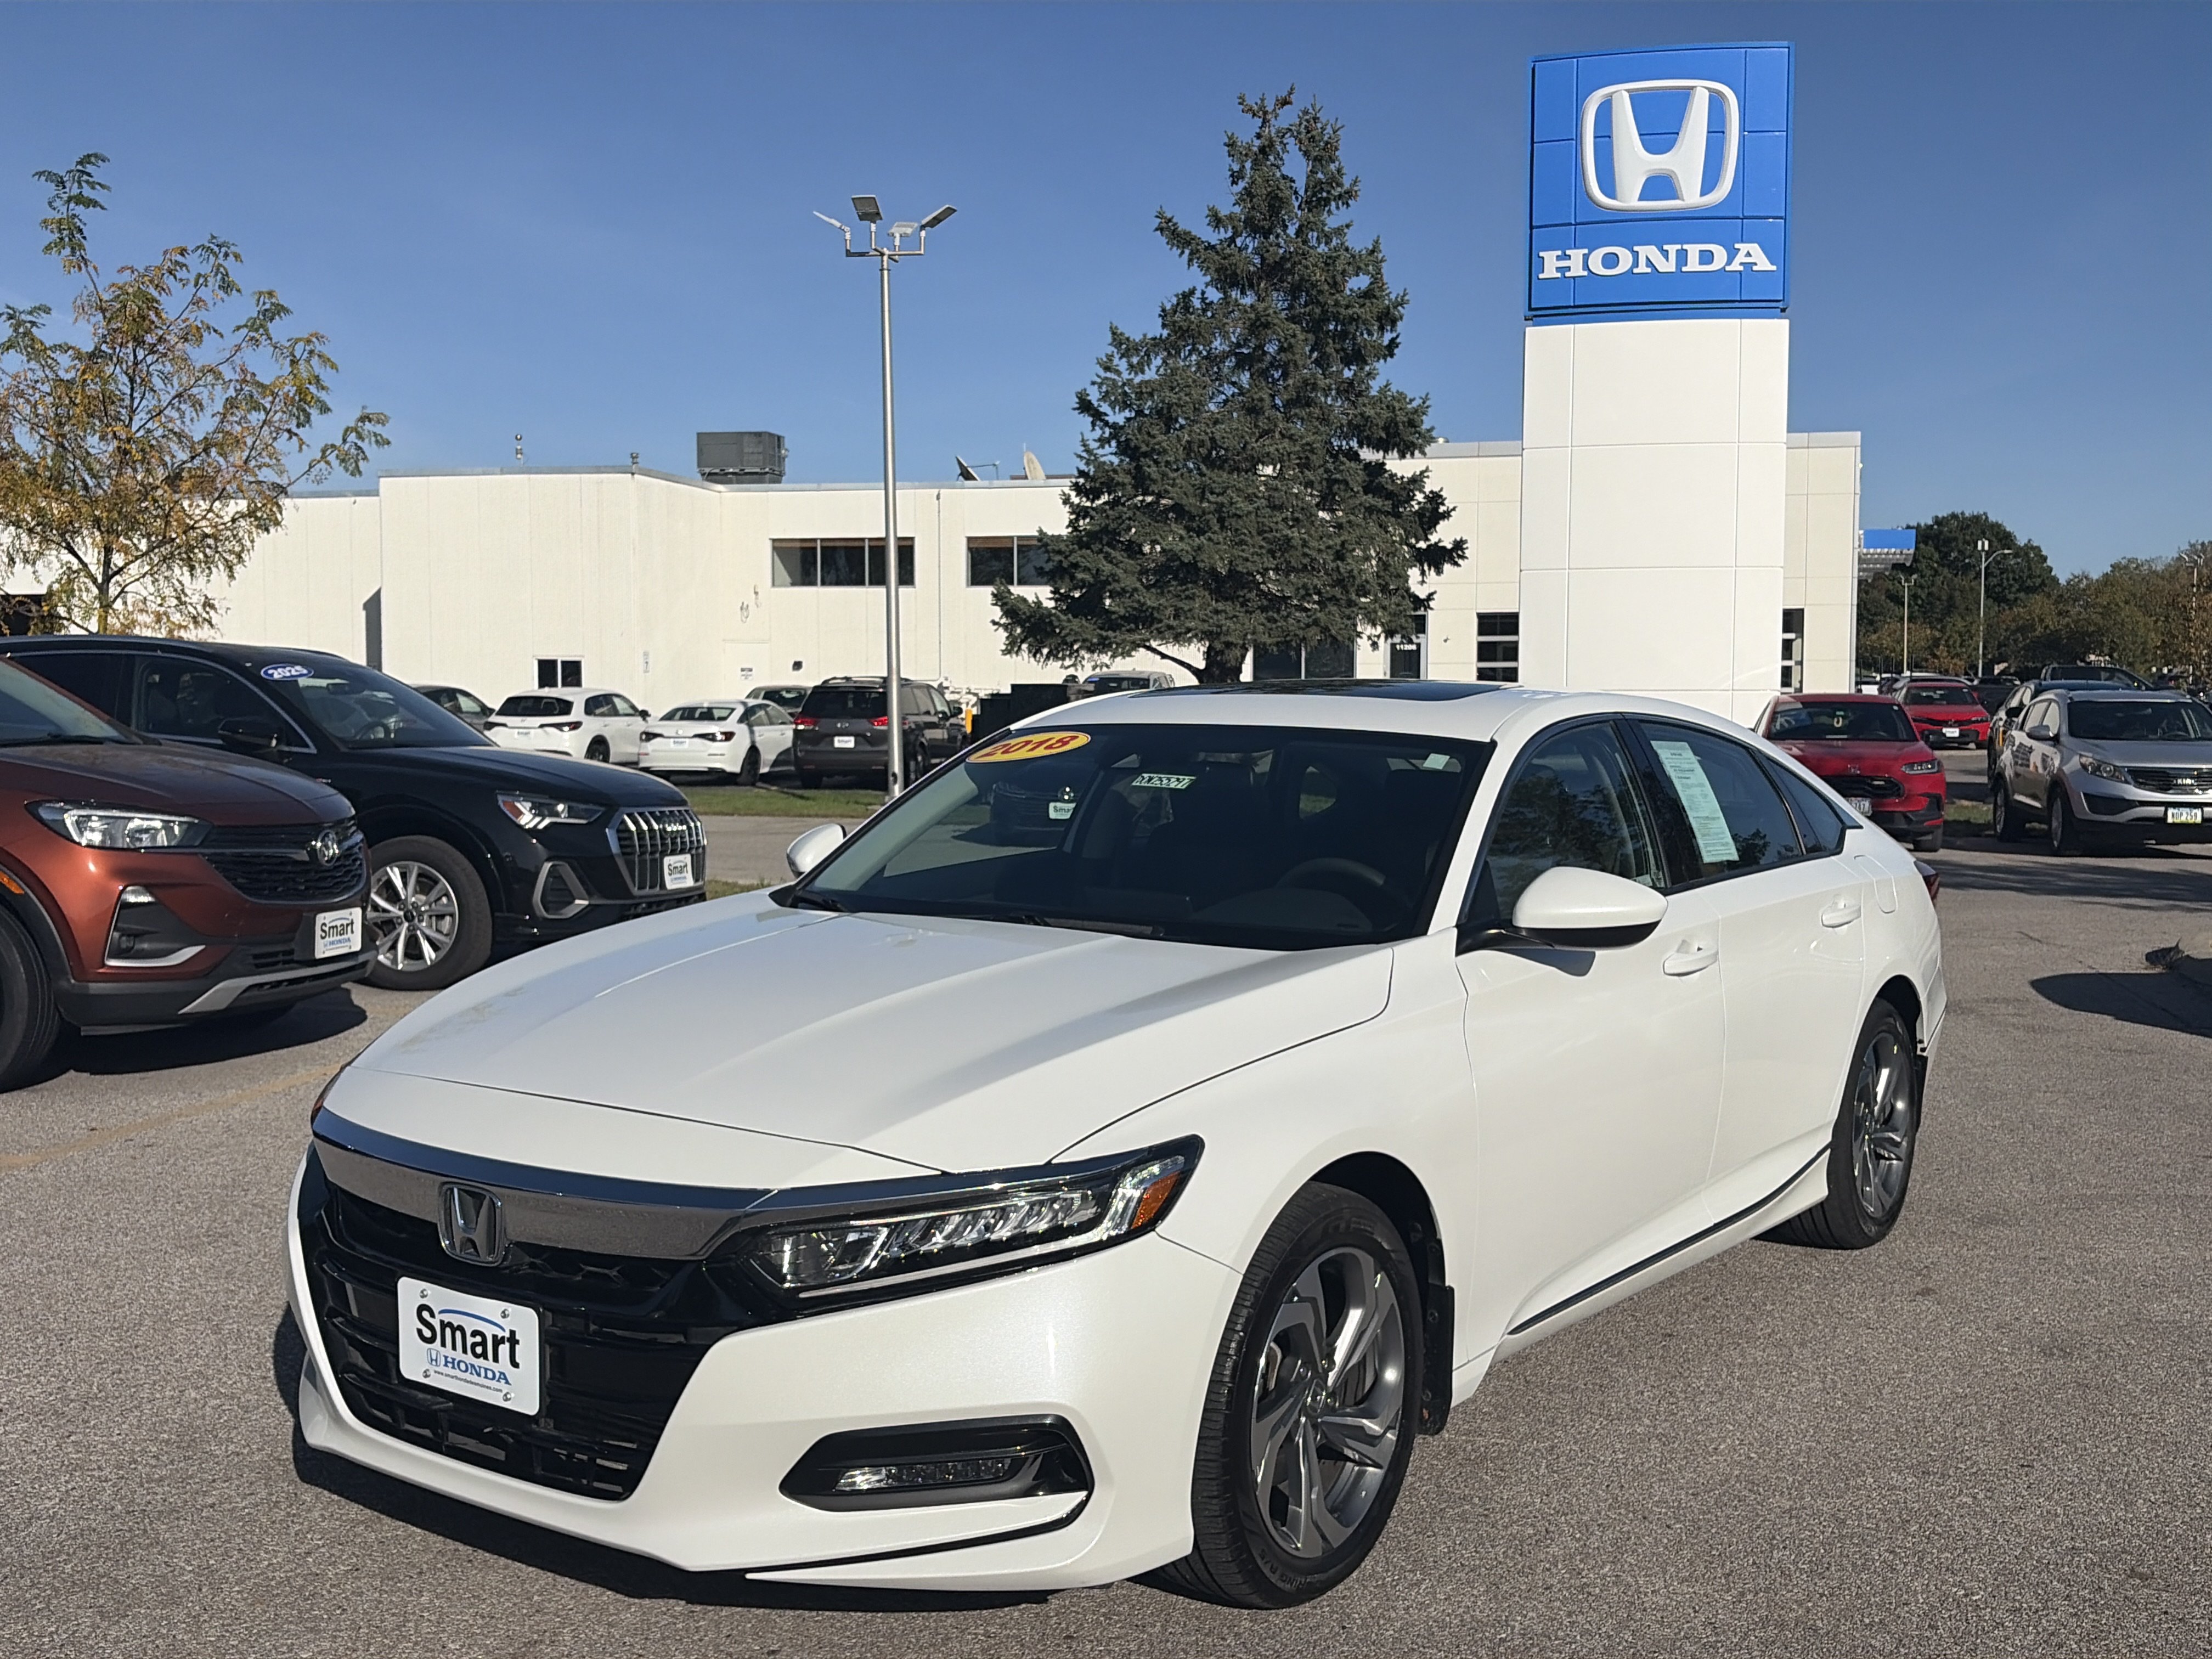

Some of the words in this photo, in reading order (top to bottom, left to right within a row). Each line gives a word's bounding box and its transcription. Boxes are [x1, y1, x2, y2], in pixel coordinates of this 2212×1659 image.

[1538, 242, 1777, 280] HONDA
[974, 735, 1080, 759] 2018
[668, 862, 689, 877] Smart
[320, 918, 354, 940] Smart
[329, 936, 351, 946] HONDA
[416, 1303, 520, 1369] Smart
[443, 1354, 512, 1386] HONDA
